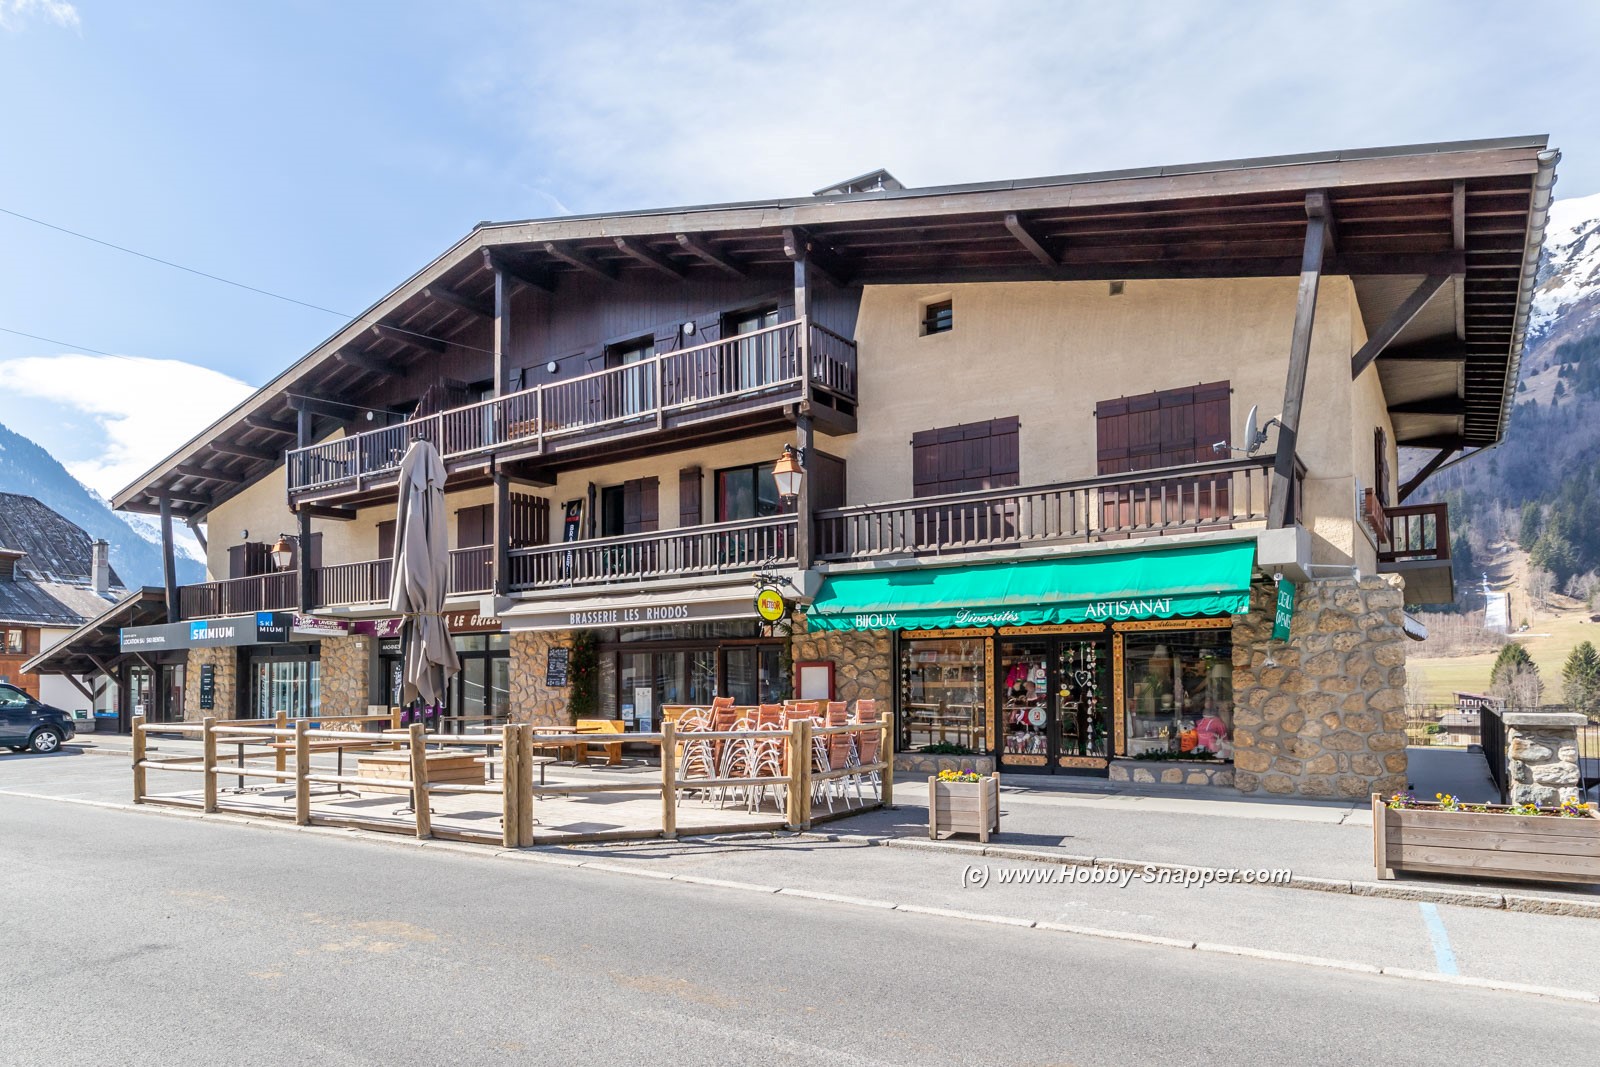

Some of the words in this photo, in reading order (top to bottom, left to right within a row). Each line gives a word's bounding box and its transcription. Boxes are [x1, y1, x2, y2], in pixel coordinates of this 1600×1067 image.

[569, 610, 617, 625] BRASSERIE
[624, 608, 639, 621] LES
[646, 605, 688, 620] RHODOS
[1085, 598, 1173, 617] ARTISANAT
[453, 615, 465, 627] LE
[856, 613, 897, 628] BIJOUX
[955, 608, 1019, 624] Diversités
[193, 626, 233, 640] SKIMIUM
